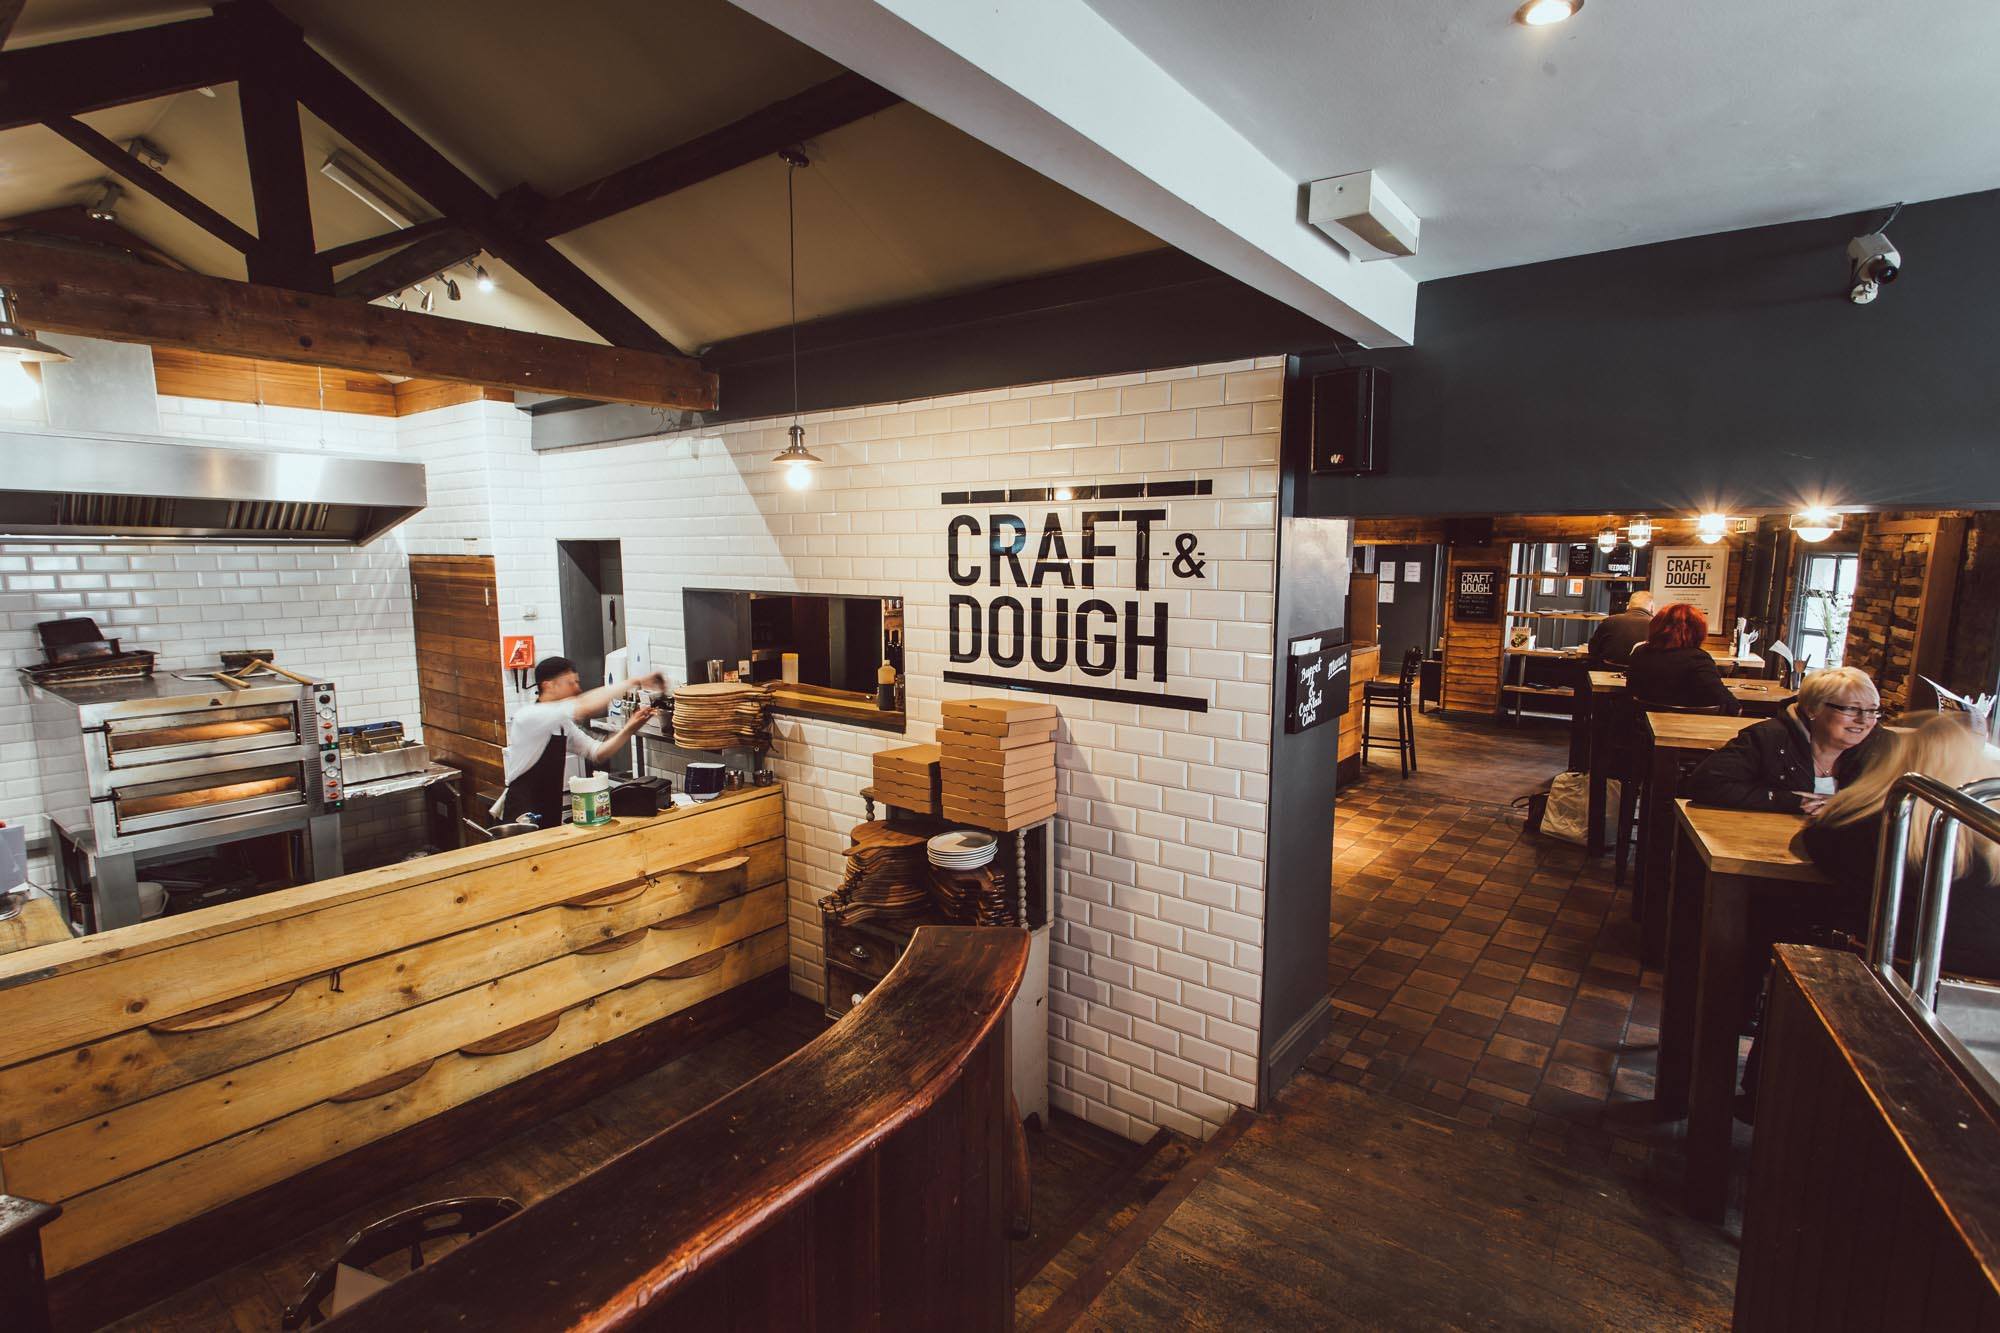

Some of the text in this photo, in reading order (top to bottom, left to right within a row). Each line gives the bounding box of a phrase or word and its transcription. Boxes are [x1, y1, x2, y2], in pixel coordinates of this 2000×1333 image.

[948, 509, 1167, 591] CRAFT
[1667, 560, 1706, 572] CRAFT
[1461, 575, 1490, 583] CRAFT
[1666, 573, 1706, 585] DOUGH
[1461, 584, 1490, 592] DOUGH
[949, 594, 1169, 683] DOUGH
